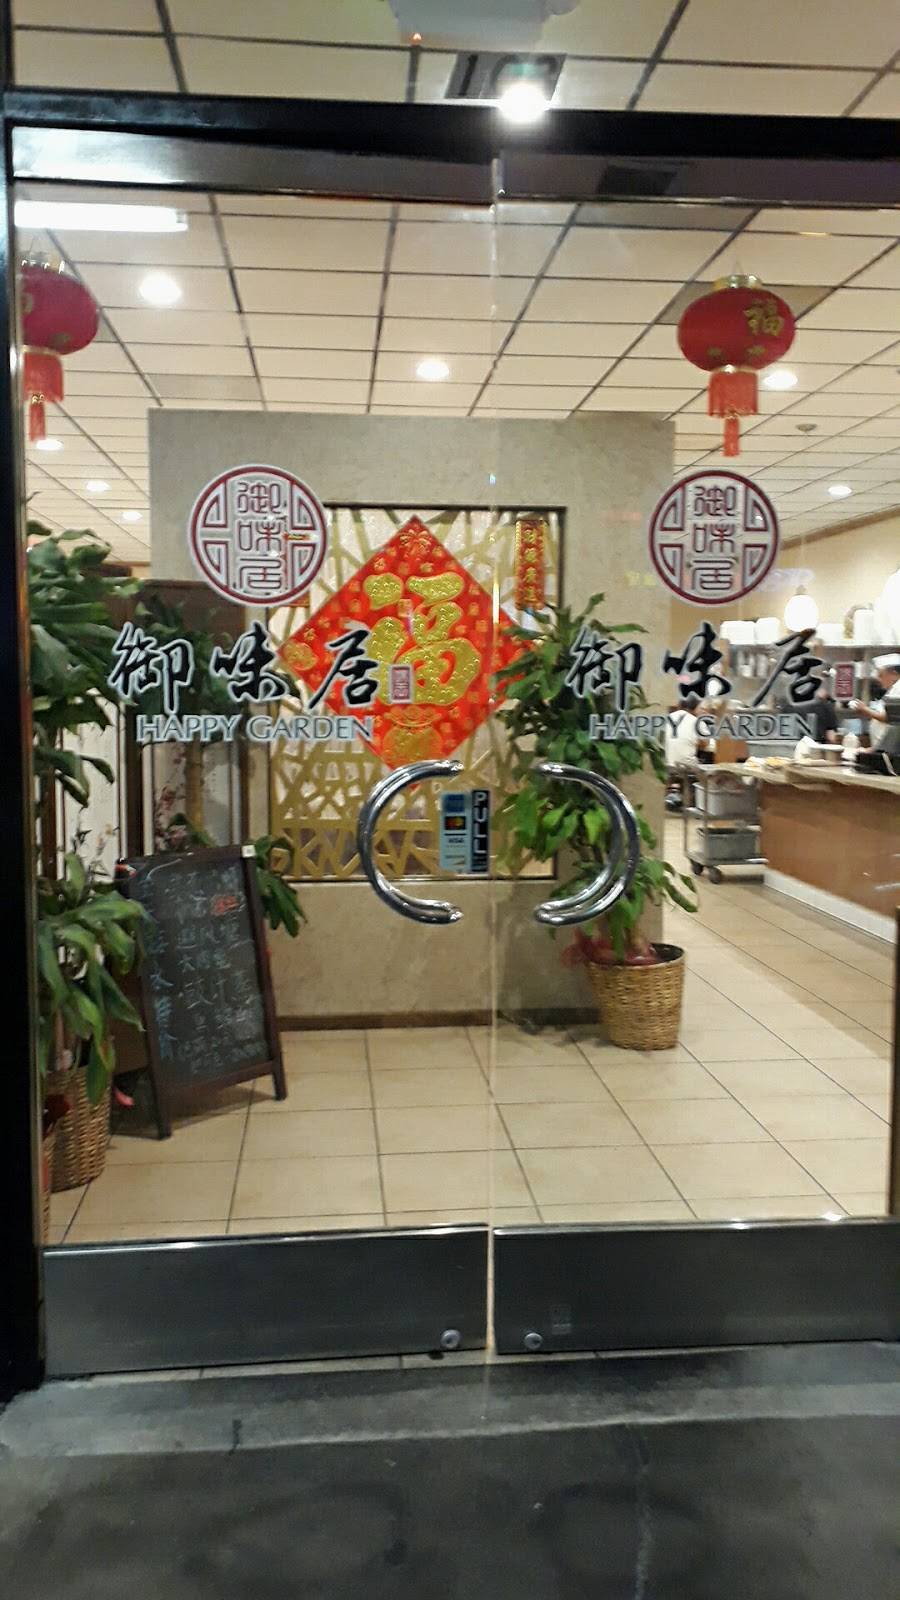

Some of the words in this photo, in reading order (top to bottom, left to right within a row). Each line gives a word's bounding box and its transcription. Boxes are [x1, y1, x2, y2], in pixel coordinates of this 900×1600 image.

[108, 622, 379, 712] 御味居
[565, 622, 824, 711] 御味居
[136, 714, 241, 742] HAPPY
[246, 716, 374, 742] GARDEN
[589, 714, 684, 740] HAPPY
[695, 713, 818, 739] GARDEN
[473, 791, 488, 854] PULL
